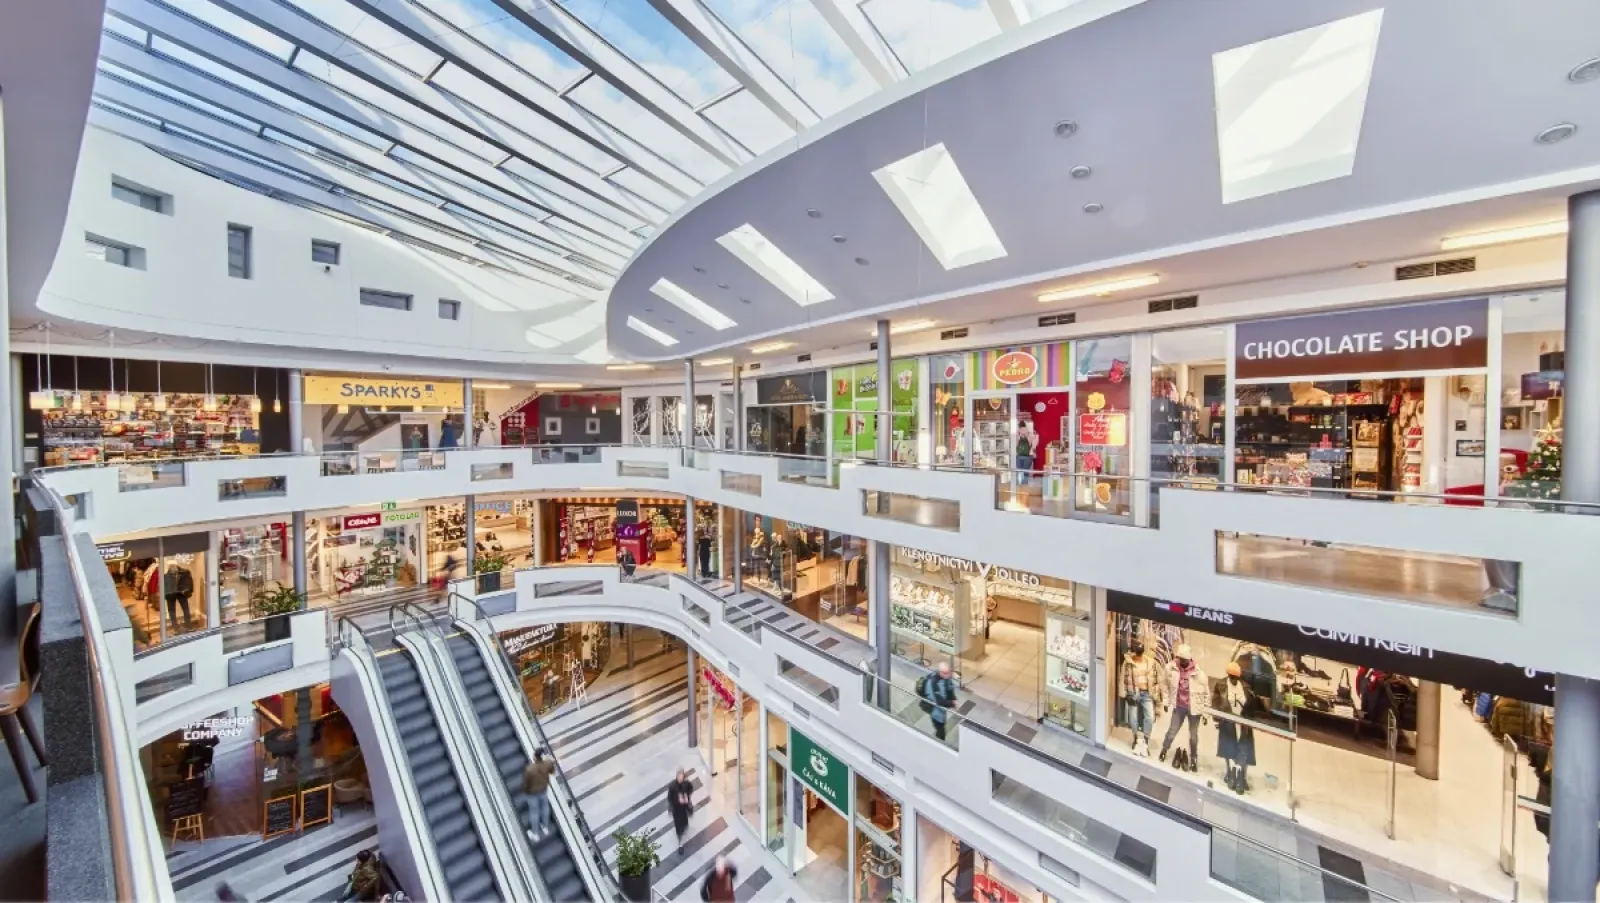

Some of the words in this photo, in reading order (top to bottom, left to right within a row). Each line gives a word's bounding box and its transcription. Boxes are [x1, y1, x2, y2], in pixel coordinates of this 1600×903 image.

[1244, 332, 1383, 360] CHOCOLATE
[1394, 325, 1473, 350] SHOP
[1000, 367, 1030, 377] PEDRO
[341, 383, 421, 399] SPARKYS
[993, 566, 1041, 586] JOLLEO
[1184, 606, 1234, 625] JEANS
[184, 727, 243, 741] COMPANY
